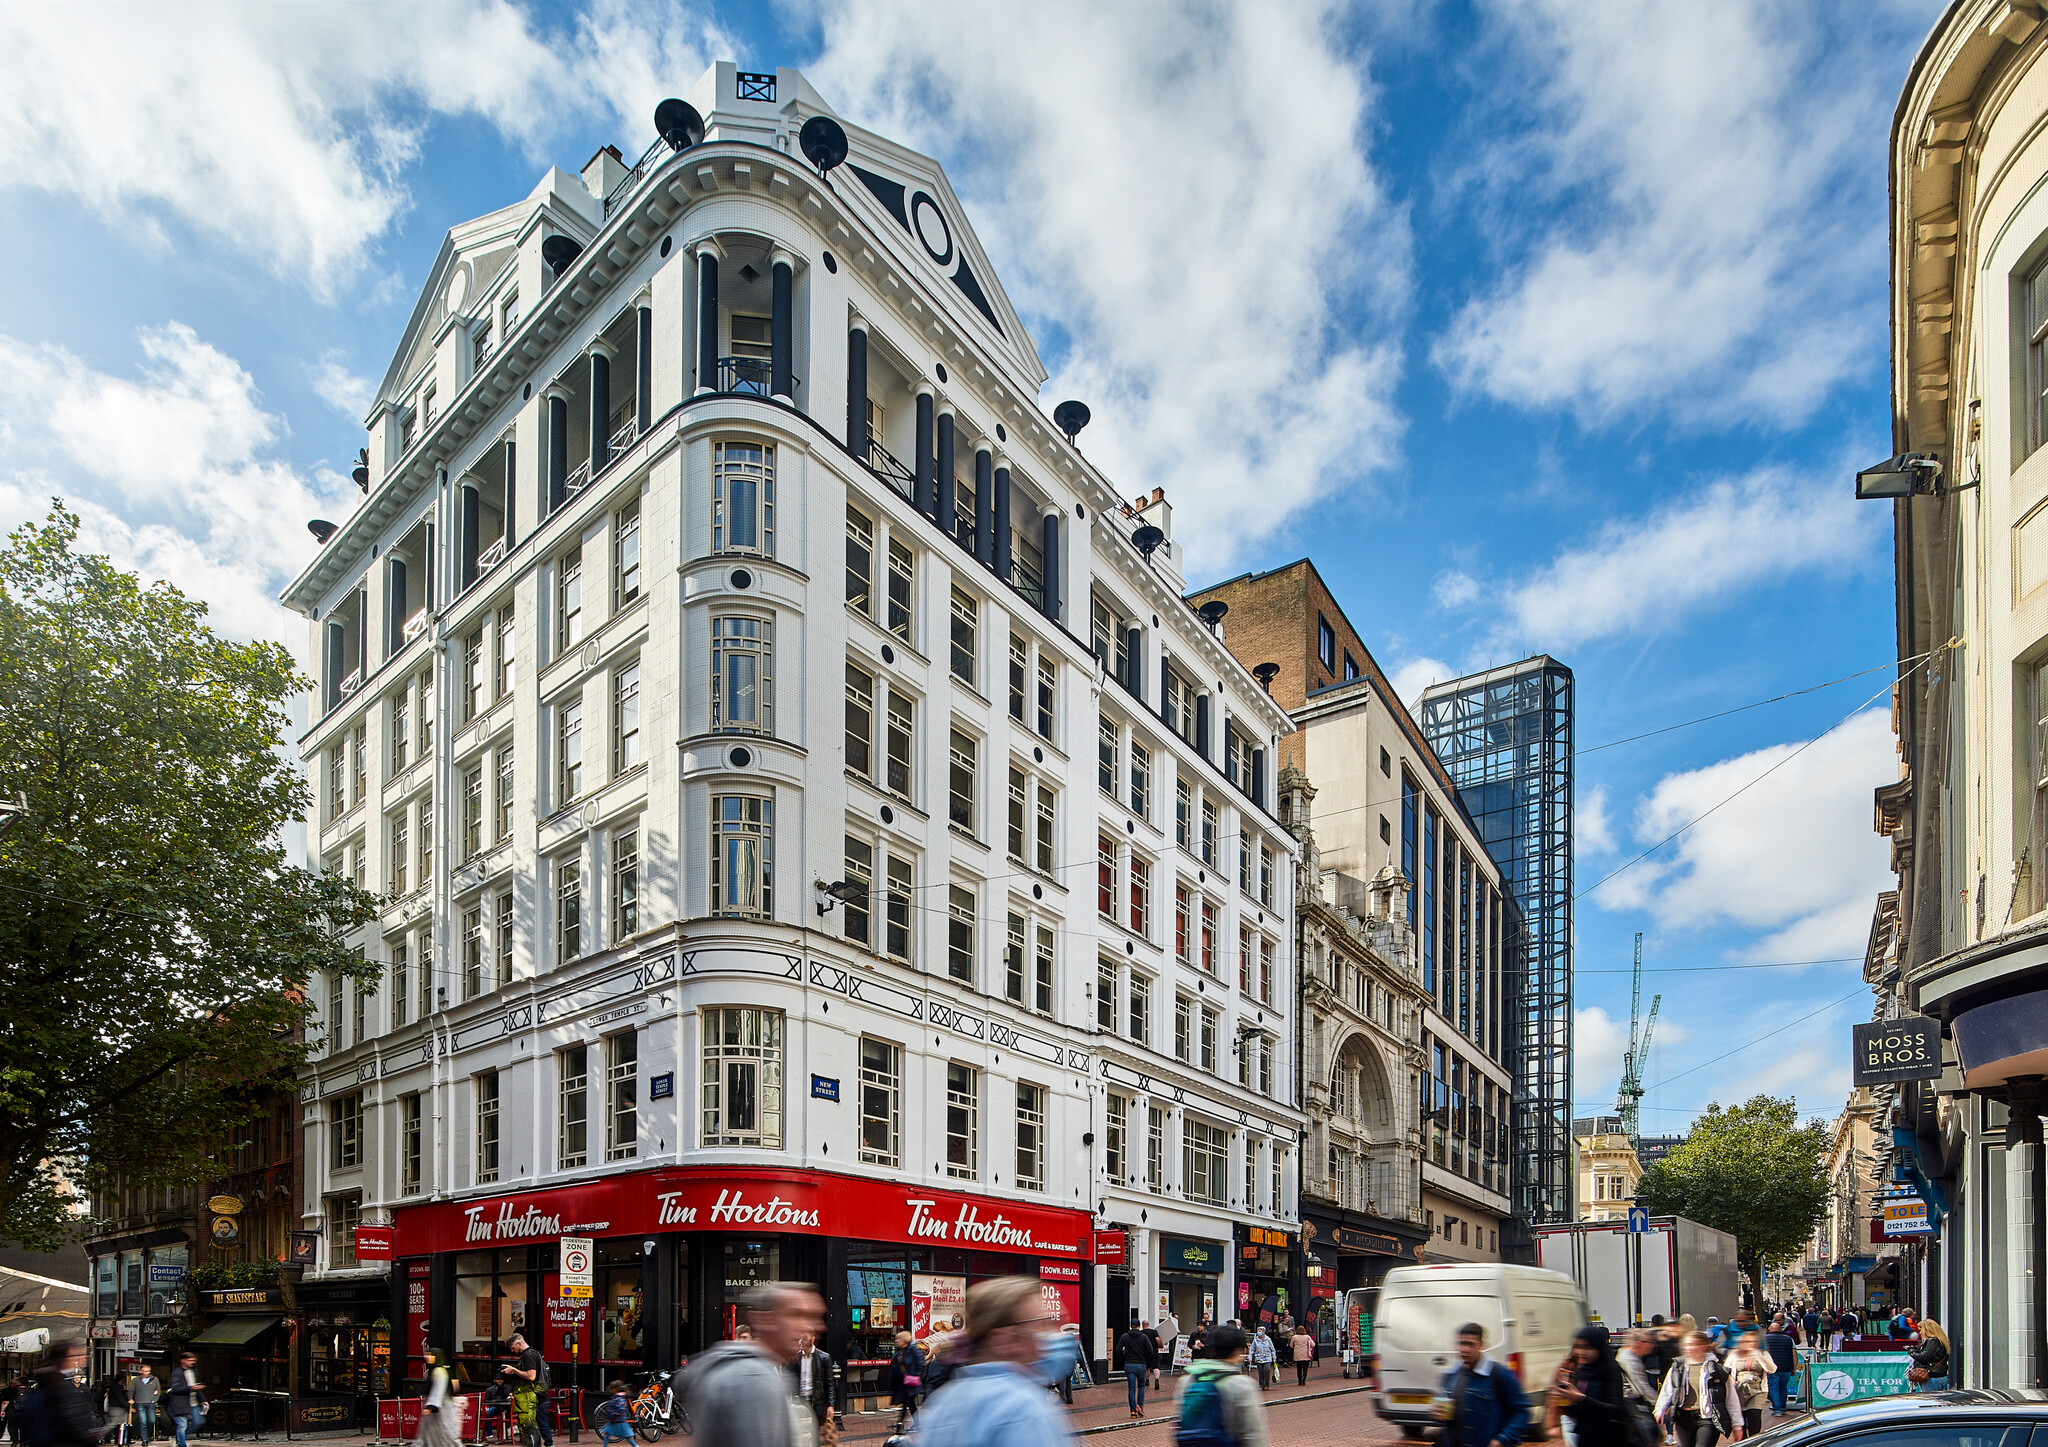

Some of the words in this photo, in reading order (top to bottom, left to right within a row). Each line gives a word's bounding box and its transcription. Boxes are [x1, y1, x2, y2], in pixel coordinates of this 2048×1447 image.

[593, 1014, 608, 1024] LOWER
[611, 1009, 629, 1018] TEMPLE
[1869, 1033, 1925, 1051] MOSS
[1869, 1048, 1931, 1066] BROS.
[815, 1086, 836, 1096] STREET
[656, 1191, 698, 1225] Tim
[1891, 1207, 1908, 1217] TO
[1910, 1205, 1927, 1215] LE
[464, 1206, 493, 1243] Tim
[595, 1221, 610, 1230] SHOP
[906, 1199, 948, 1239] Tim
[1034, 1241, 1047, 1249] CAFÉ
[1249, 1226, 1264, 1244] WOK
[1272, 1230, 1288, 1248] WALK
[1356, 1234, 1386, 1248] PICCADILLY
[739, 1256, 765, 1264] CAFÉ
[152, 1267, 181, 1275] Contact
[749, 1268, 756, 1276] &
[1045, 1266, 1061, 1274] DOWN.
[1062, 1268, 1079, 1276] RELAX.
[409, 1283, 425, 1294] 100+
[933, 1278, 944, 1287] Any
[933, 1286, 961, 1294] Breakfast
[1041, 1285, 1061, 1299] 00+
[213, 1293, 224, 1304] THE
[225, 1291, 267, 1304] SHAKESPEARE
[409, 1296, 425, 1304] SEATS
[546, 1297, 559, 1310] Any
[409, 1304, 425, 1313] INSIDE
[1041, 1300, 1061, 1311] EATS
[550, 1309, 567, 1321] Meal
[1881, 1378, 1903, 1386] FOR
